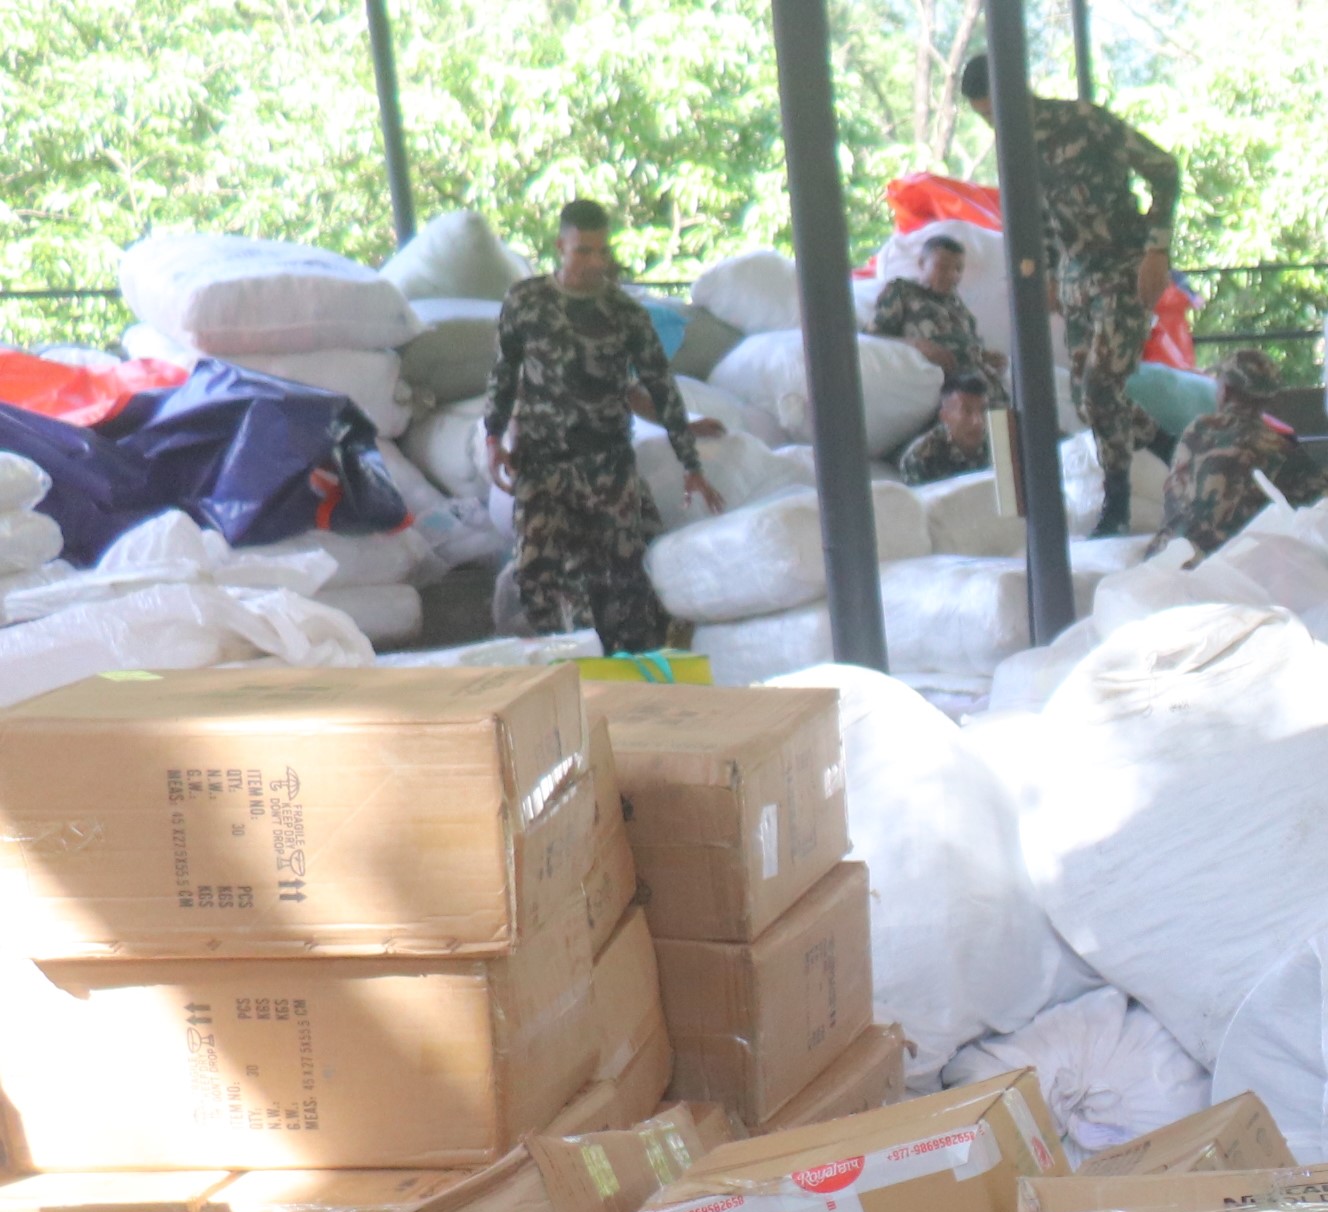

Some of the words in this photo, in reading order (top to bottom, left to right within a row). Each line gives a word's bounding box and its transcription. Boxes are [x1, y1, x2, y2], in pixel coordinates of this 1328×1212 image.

[227, 770, 242, 792] QTY:
[248, 770, 263, 796] ITEM
[282, 802, 293, 832] KEEP
[294, 804, 305, 845] FRAGILE
[232, 824, 244, 836] 30
[284, 834, 295, 849] DRY
[273, 830, 284, 854] DROP
[238, 886, 253, 908] PCS
